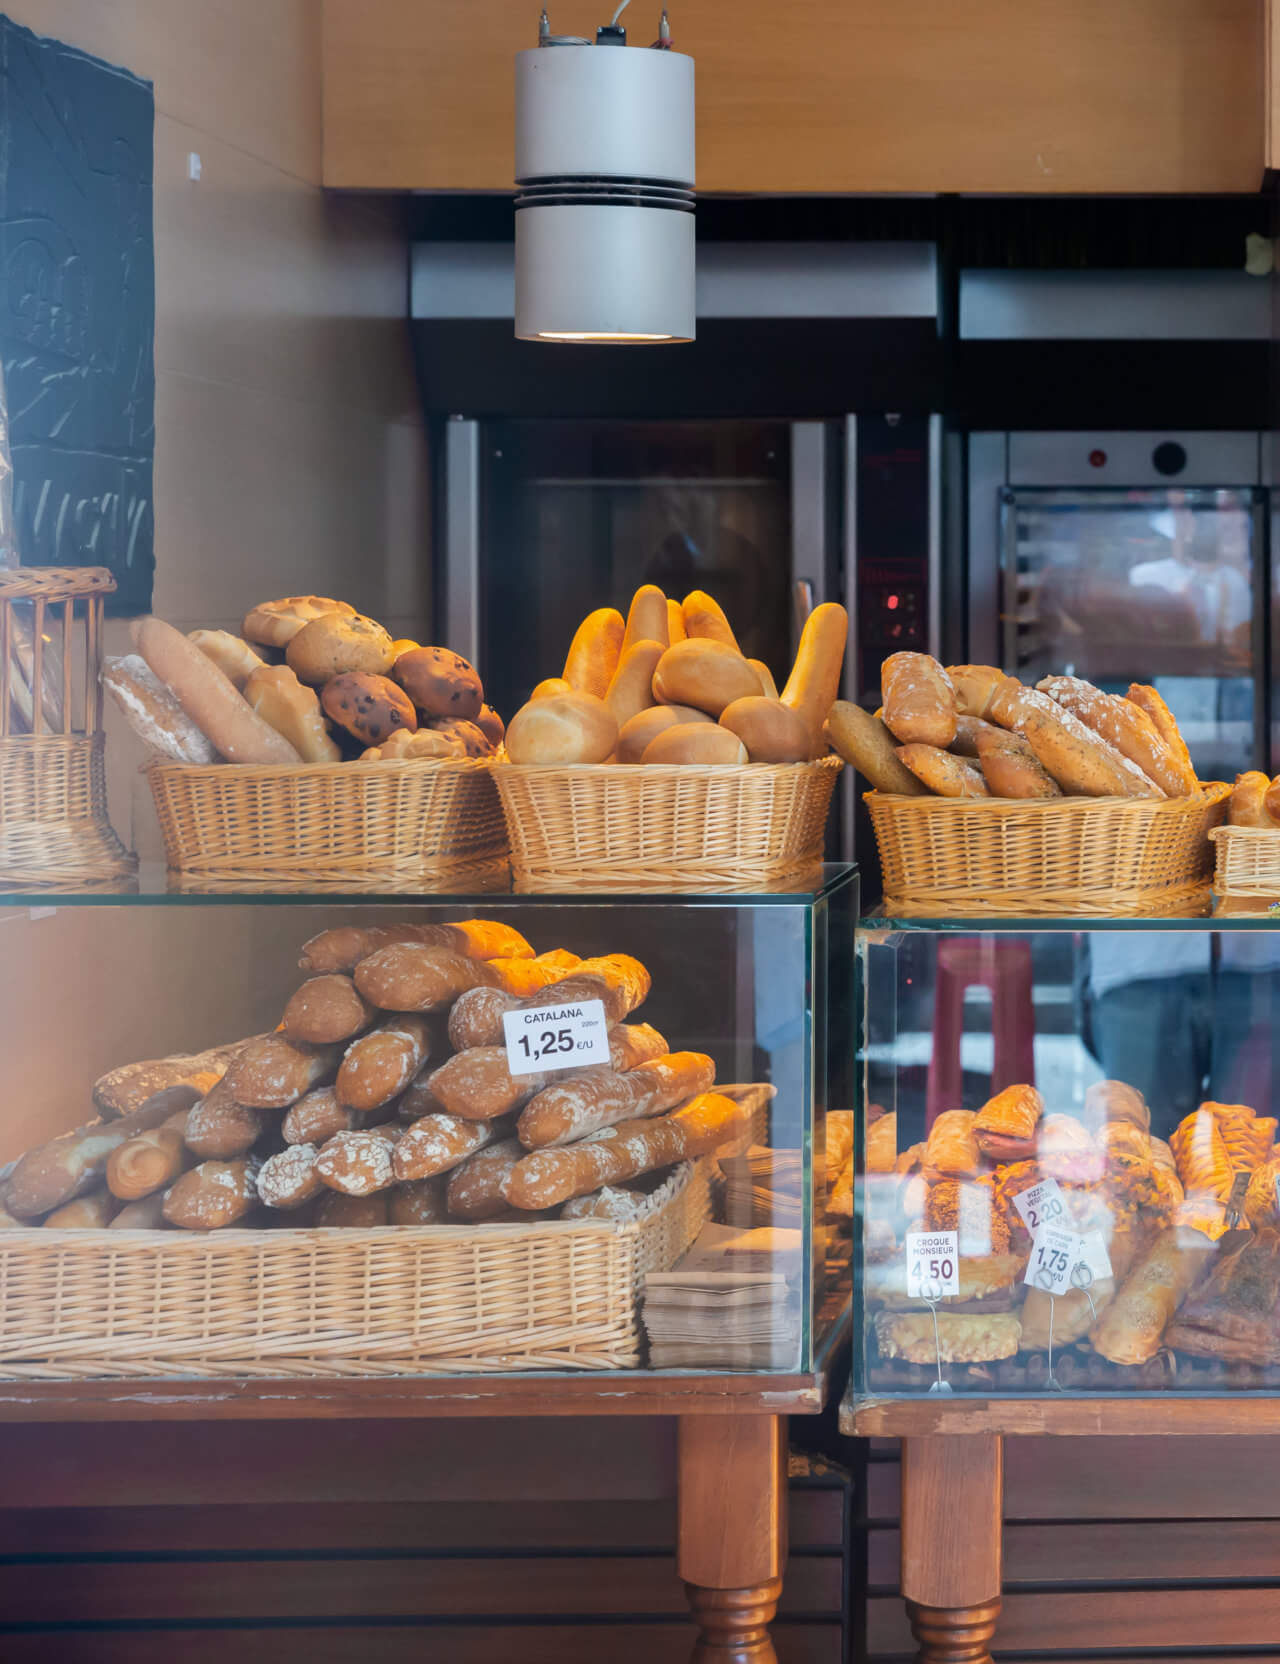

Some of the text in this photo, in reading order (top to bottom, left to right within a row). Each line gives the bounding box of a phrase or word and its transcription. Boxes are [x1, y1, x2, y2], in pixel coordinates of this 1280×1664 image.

[524, 1008, 583, 1024] CATALANA
[518, 1029, 593, 1061] 1,25 €/U
[916, 1238, 950, 1247] CROQUE
[912, 1247, 953, 1255] MONSIEUR
[1038, 1246, 1069, 1271] 1,75
